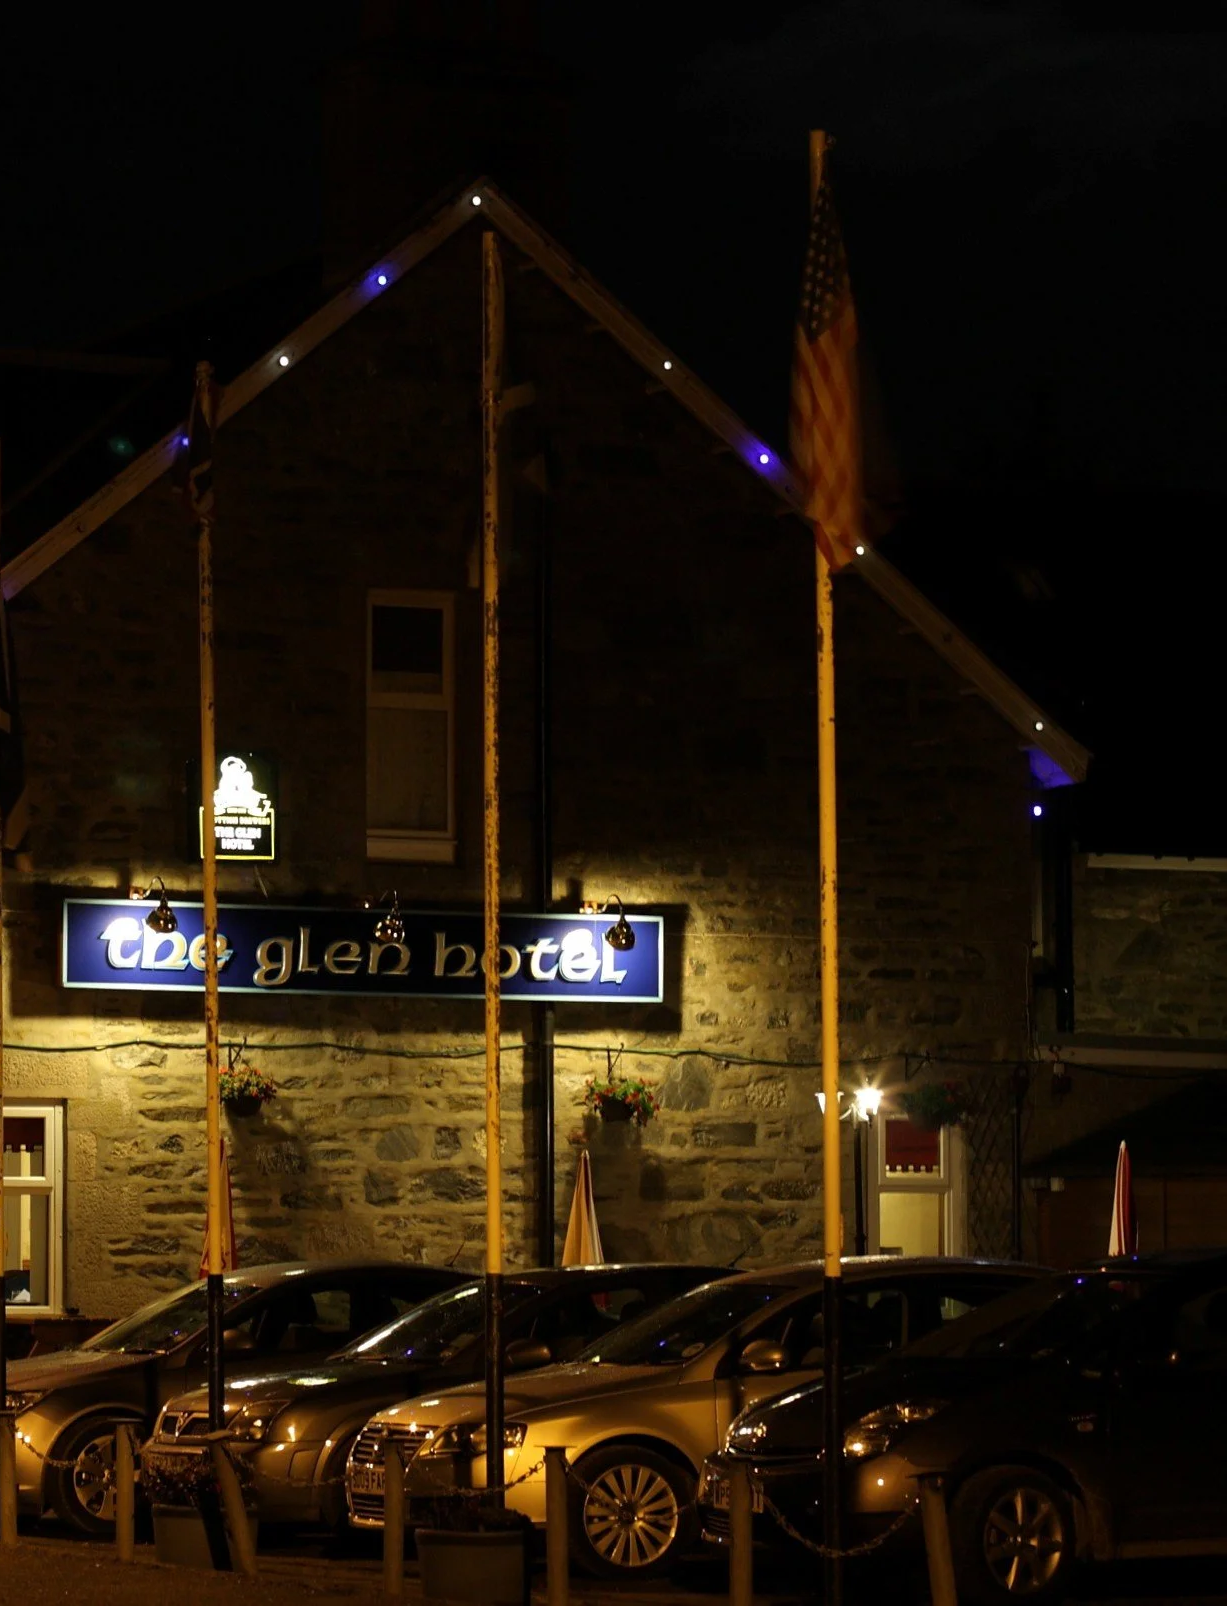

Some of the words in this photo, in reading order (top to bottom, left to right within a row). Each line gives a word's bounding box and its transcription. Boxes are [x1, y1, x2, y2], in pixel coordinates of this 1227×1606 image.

[221, 839, 254, 850] HOTEL
[100, 917, 232, 971] the
[253, 926, 411, 987] glen
[433, 928, 627, 984] hotel
